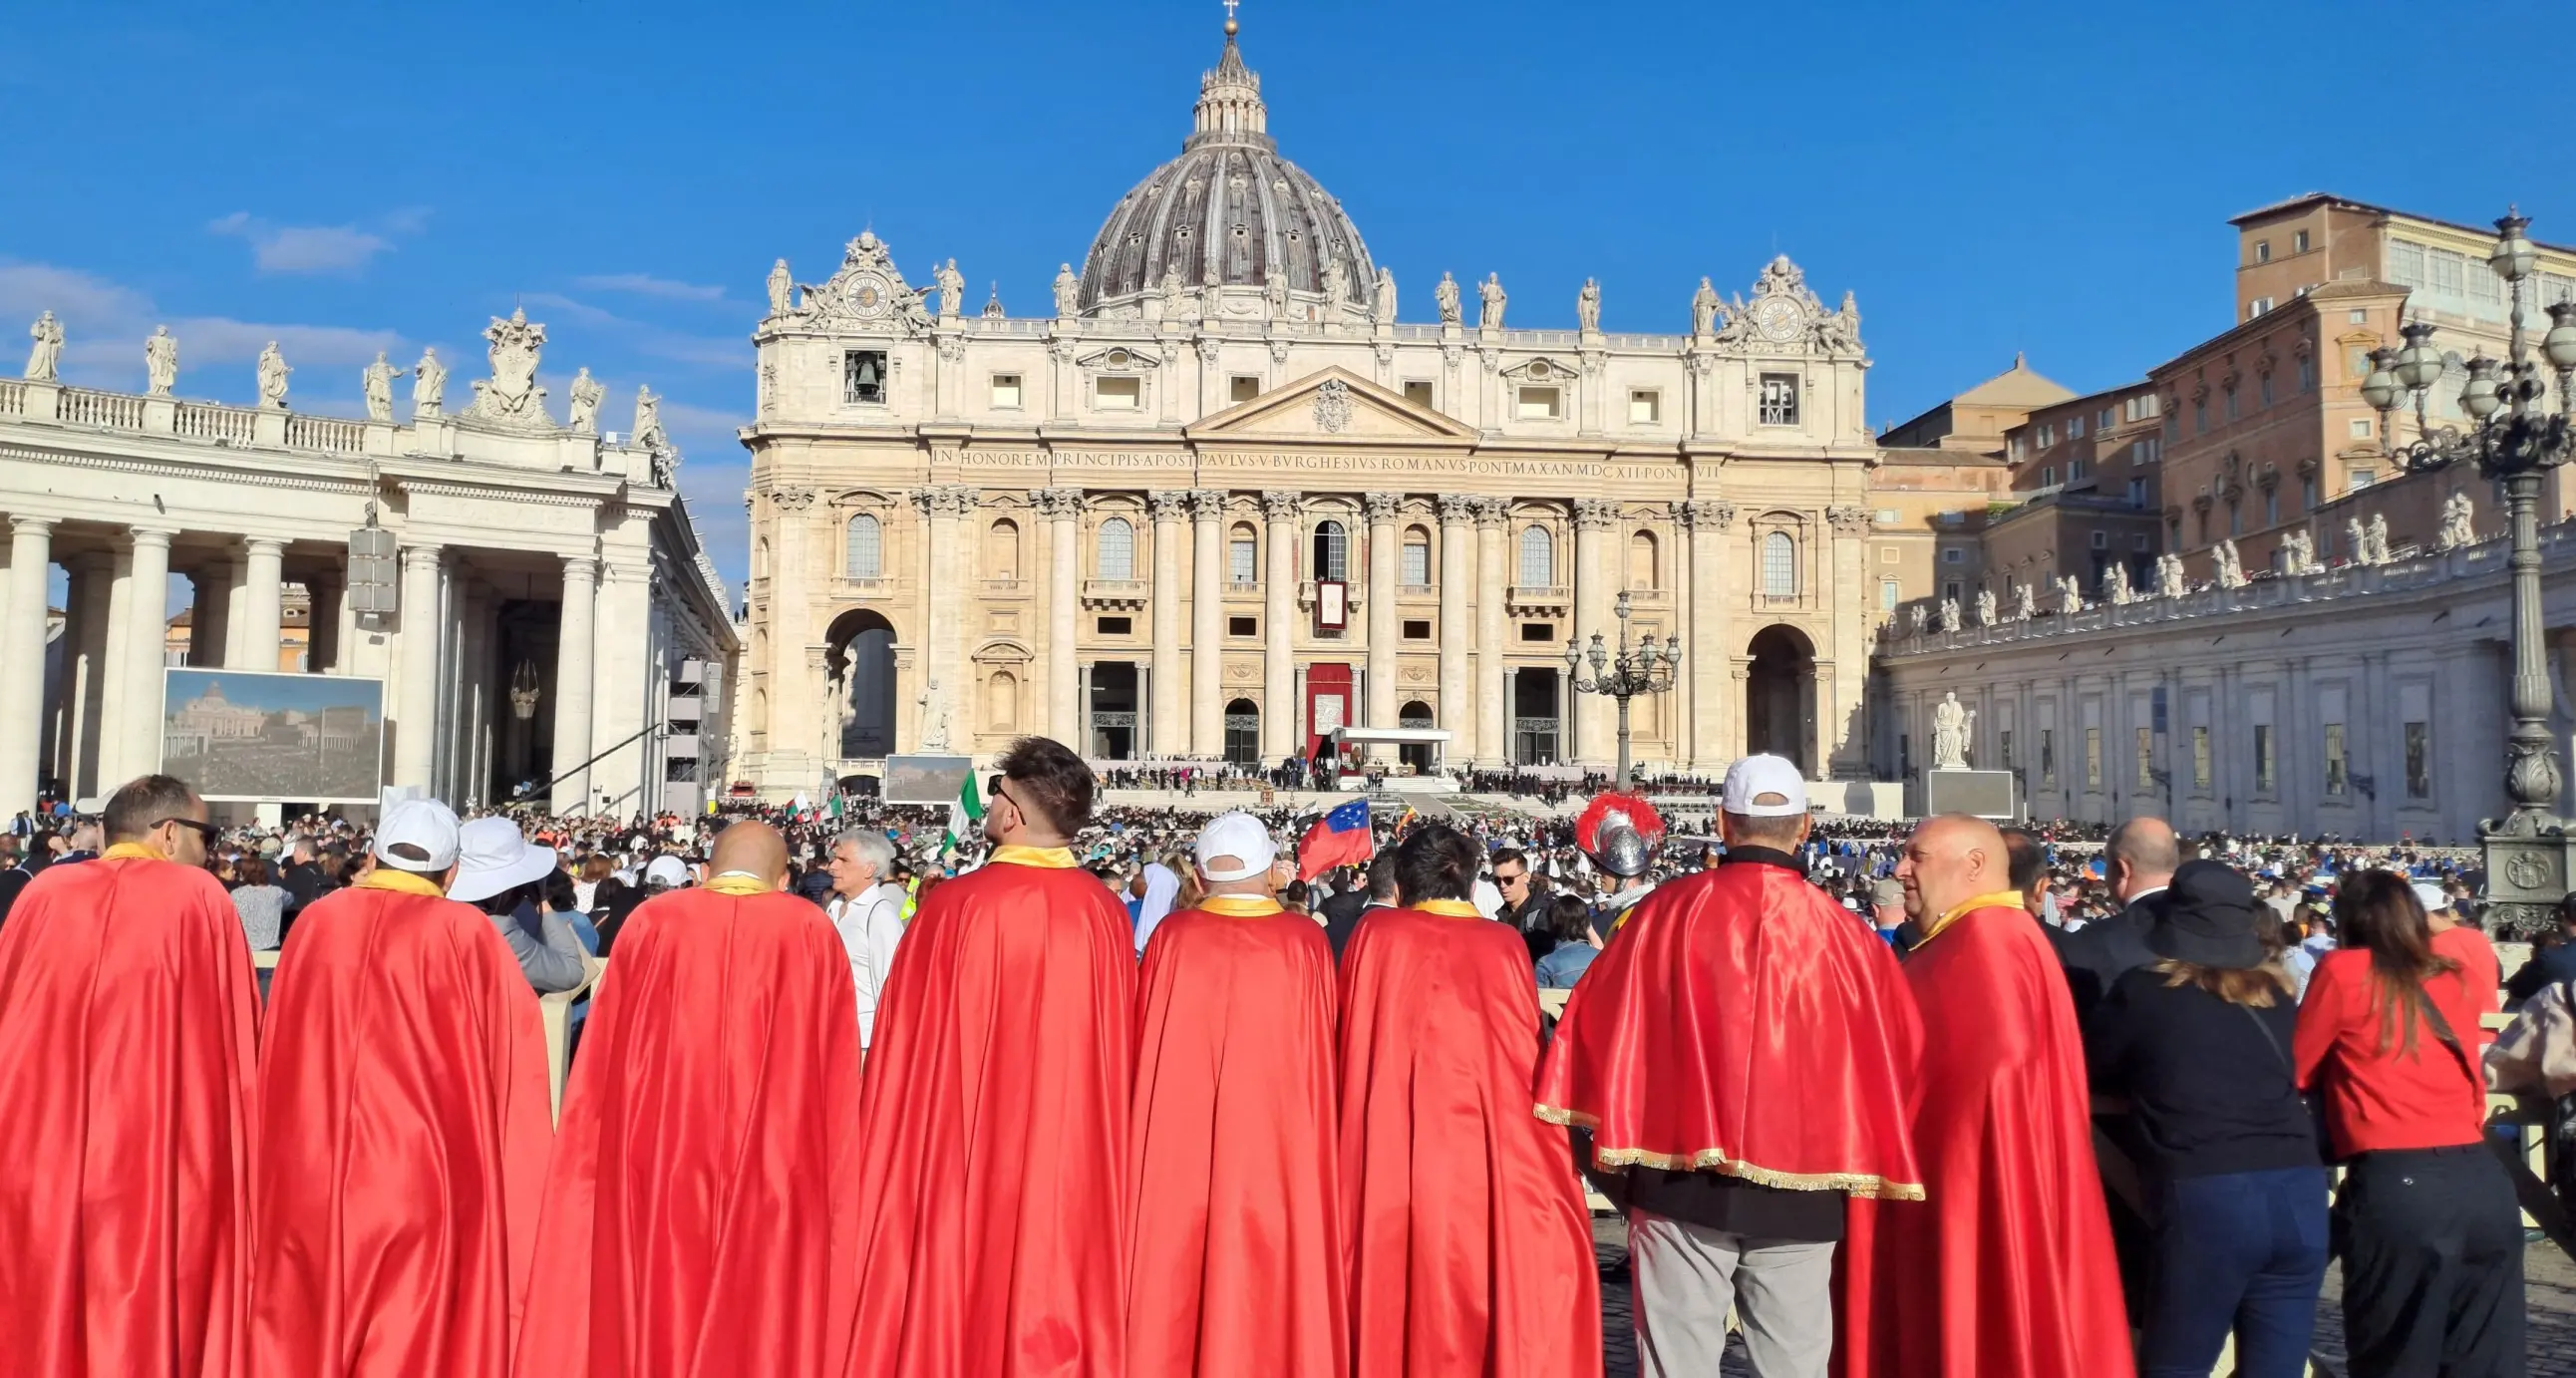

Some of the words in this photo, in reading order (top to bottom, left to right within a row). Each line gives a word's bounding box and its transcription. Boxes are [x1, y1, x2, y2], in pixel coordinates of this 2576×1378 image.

[933, 450, 952, 462] IN
[961, 453, 1047, 466] HONOREM
[1054, 453, 1139, 467] PRINCIPIS
[1143, 454, 1194, 467] APOST
[1199, 454, 1255, 467] PAVLVS
[1259, 455, 1268, 467] V
[1273, 456, 1377, 470] BVRGHESIVS
[1382, 458, 1466, 472] ROMANVS
[1468, 461, 1511, 474] PONT
[1512, 462, 1548, 475] MAX
[1550, 464, 1572, 476] AN
[1576, 464, 1640, 479] MDCXII
[1644, 467, 1686, 480] PONT
[1695, 466, 1719, 478] VII
